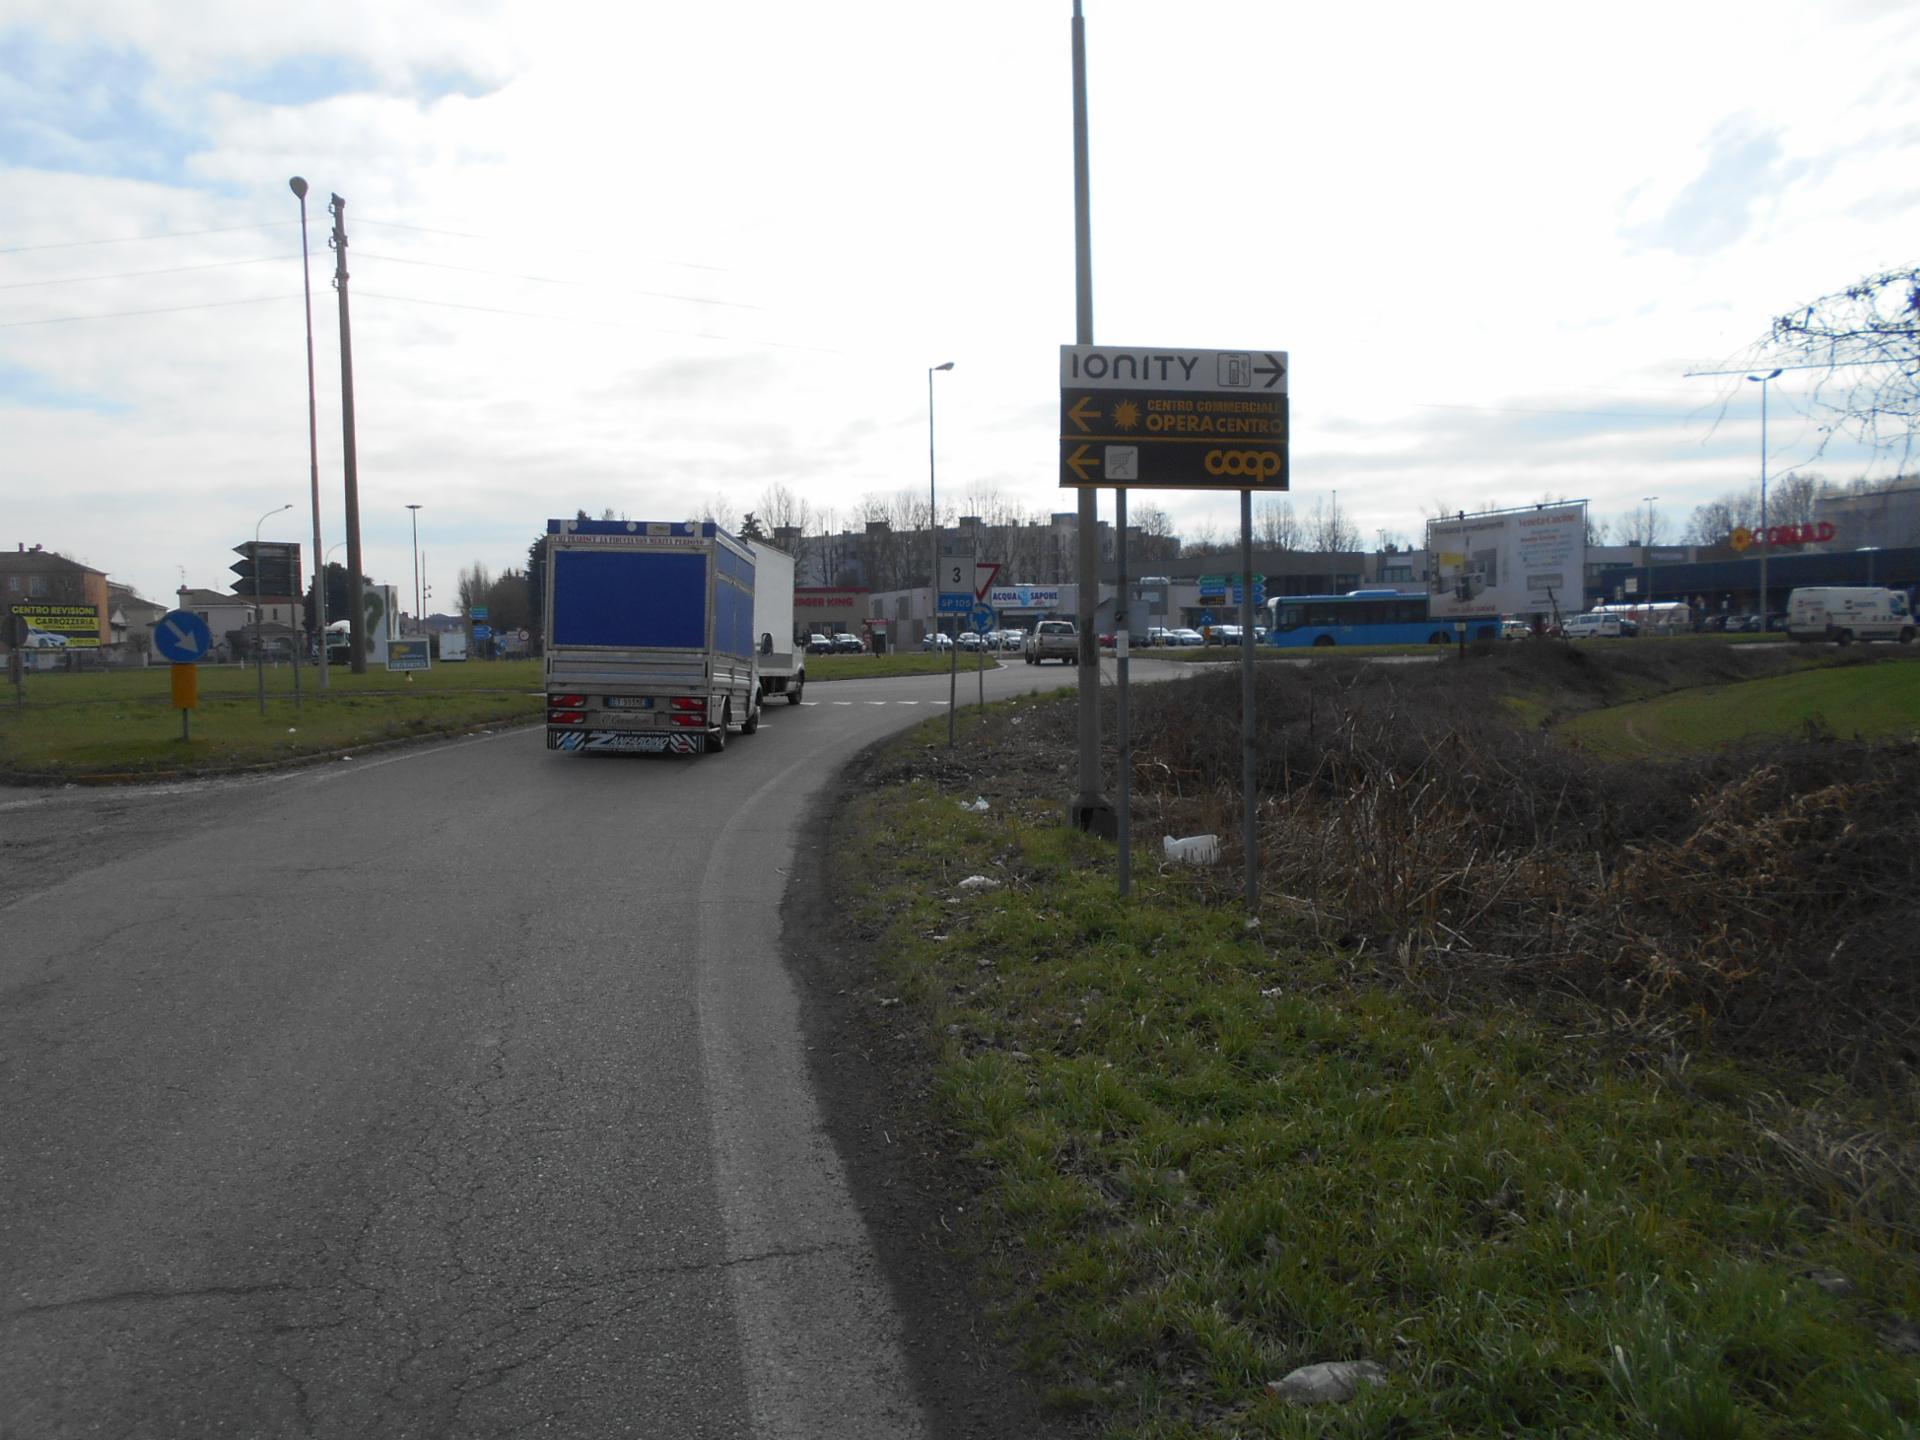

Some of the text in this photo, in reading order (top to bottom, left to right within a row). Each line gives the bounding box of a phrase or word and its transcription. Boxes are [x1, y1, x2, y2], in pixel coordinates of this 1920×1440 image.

[1072, 353, 1199, 381] IONITY
[1147, 400, 1282, 414] CENTRO COMMERCIALE
[1204, 449, 1281, 481] coop
[952, 567, 962, 583] 3
[992, 592, 1058, 601] ACQUA SAPONE
[12, 606, 95, 615] CENTRO REVISIONI
[35, 618, 95, 626] CARROZZERIA
